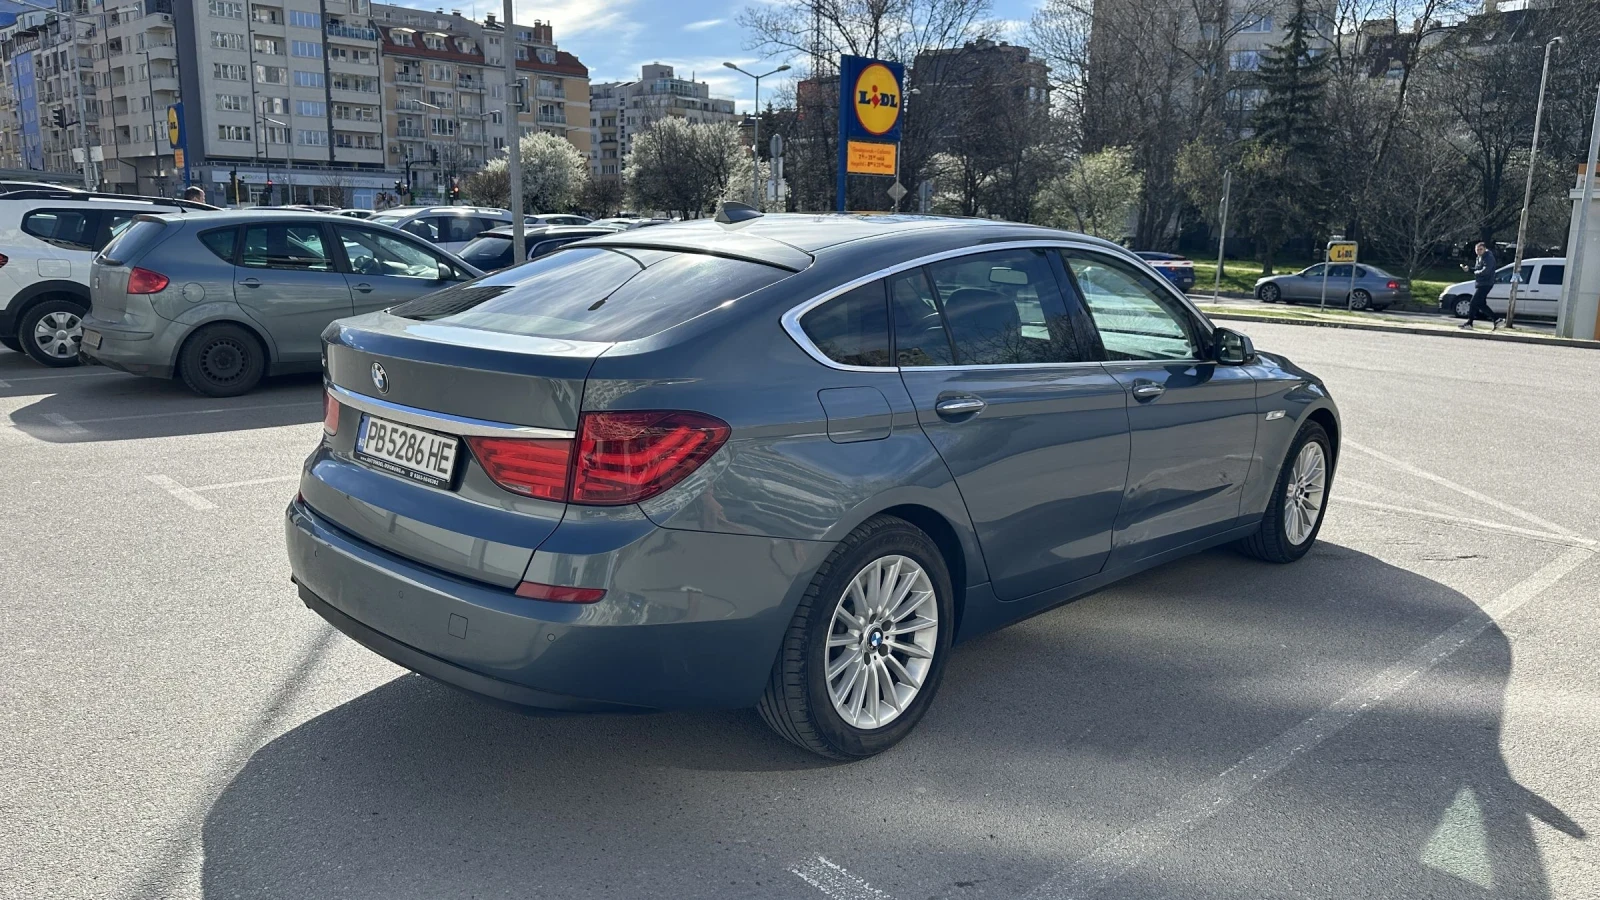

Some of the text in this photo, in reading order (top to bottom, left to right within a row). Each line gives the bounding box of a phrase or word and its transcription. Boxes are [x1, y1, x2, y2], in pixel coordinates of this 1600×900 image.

[366, 421, 453, 474] PB 5286 HE
